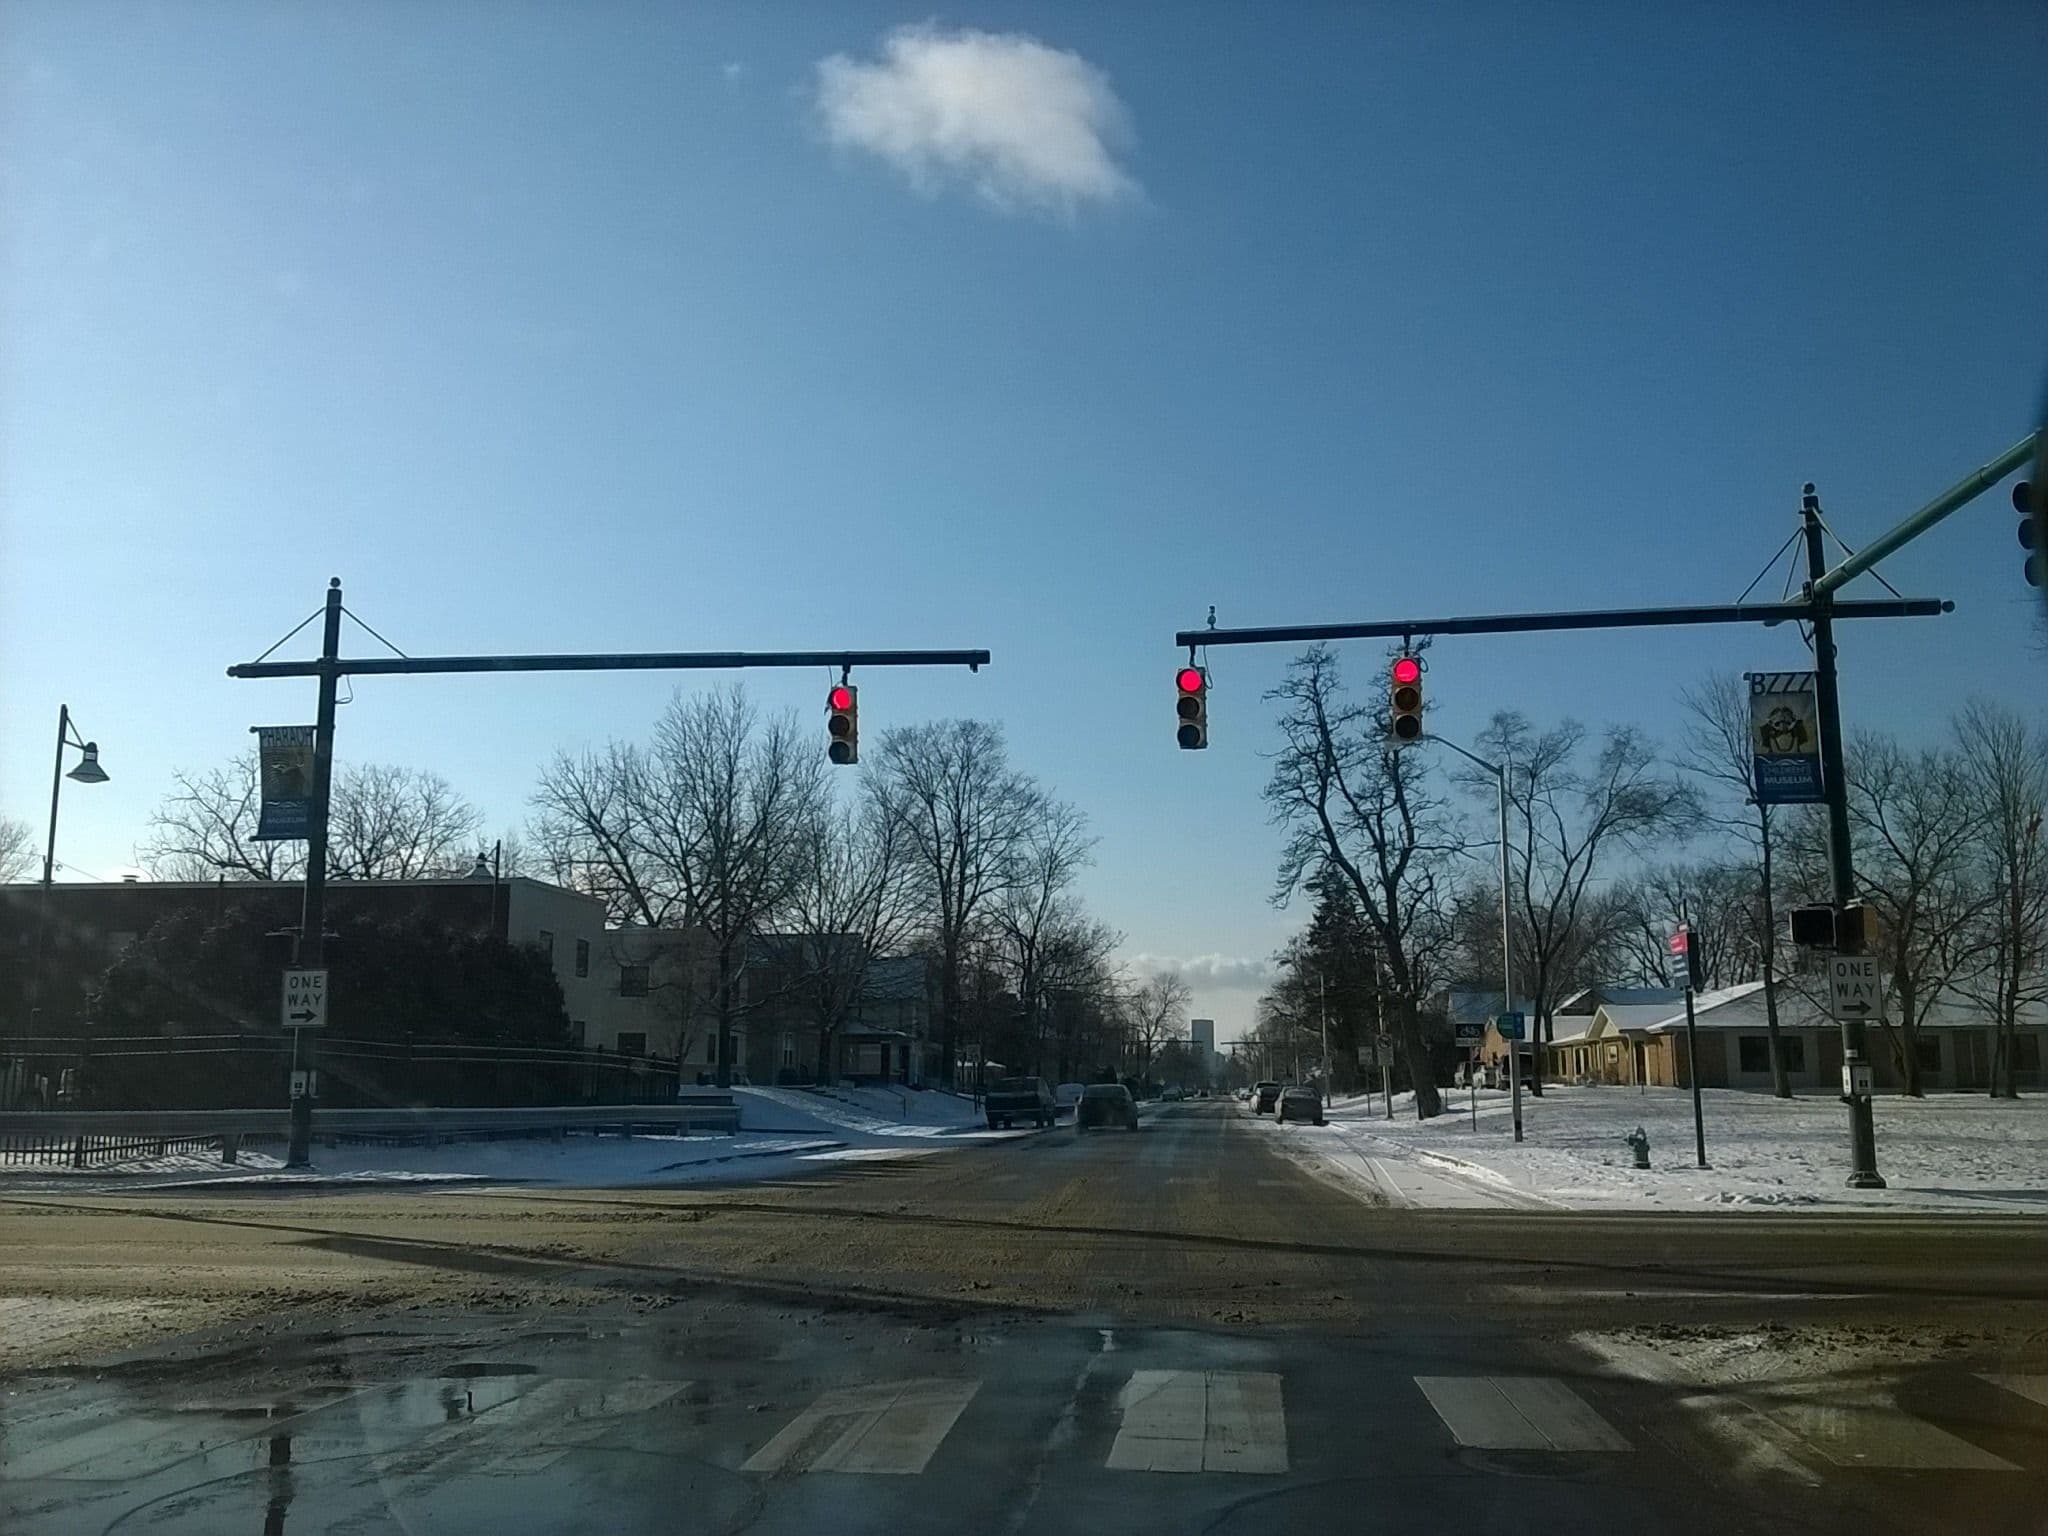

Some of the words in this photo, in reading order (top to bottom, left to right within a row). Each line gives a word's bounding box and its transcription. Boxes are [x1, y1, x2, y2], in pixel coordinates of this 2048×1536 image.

[1751, 672, 1813, 695] BZZZ
[1763, 775, 1814, 785] MUSEUM
[1836, 962, 1873, 977] ONE
[290, 975, 322, 989] ONE
[1837, 983, 1876, 998] WAY
[288, 993, 323, 1006] WAY
